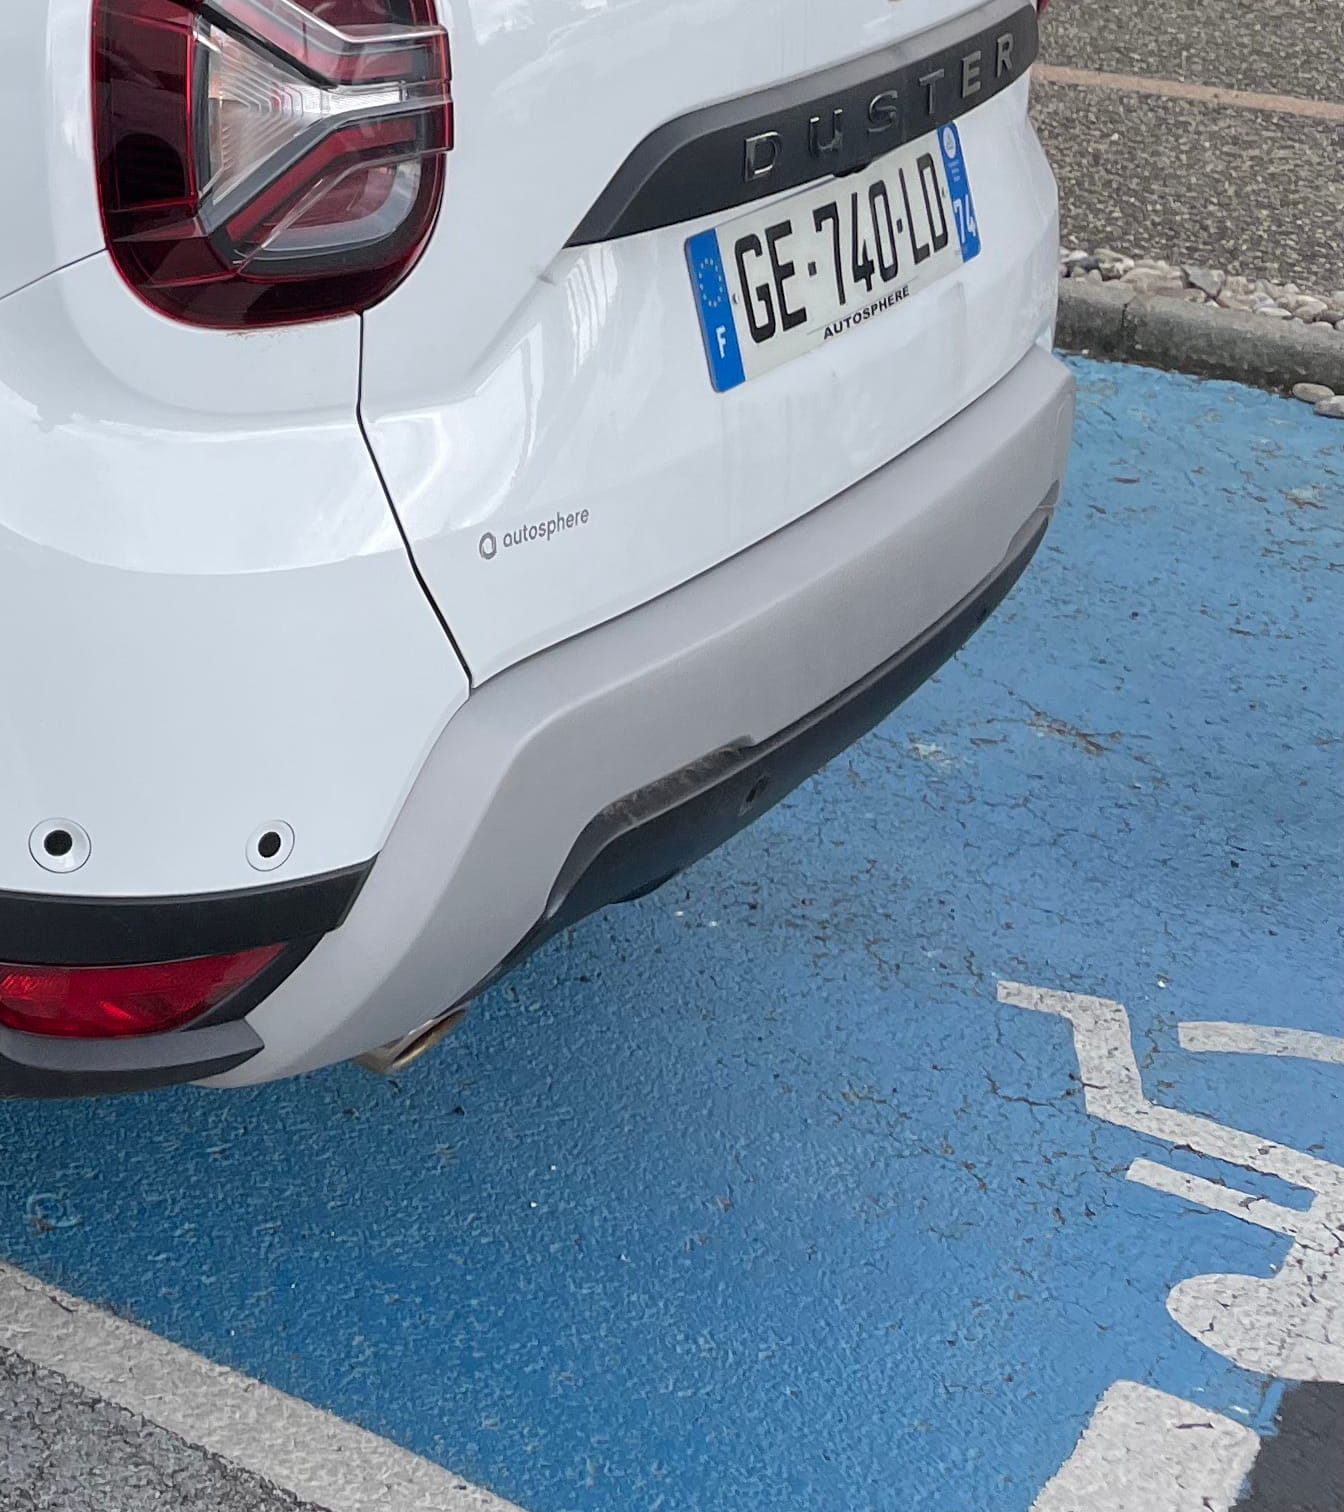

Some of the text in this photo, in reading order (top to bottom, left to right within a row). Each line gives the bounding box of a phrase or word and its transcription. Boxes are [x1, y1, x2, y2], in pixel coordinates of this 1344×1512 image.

[744, 33, 1016, 182] DUSTER
[953, 194, 977, 243] 74
[823, 286, 911, 341] AUTOSPHERE
[715, 326, 729, 359] F
[502, 508, 590, 548] autosphere
